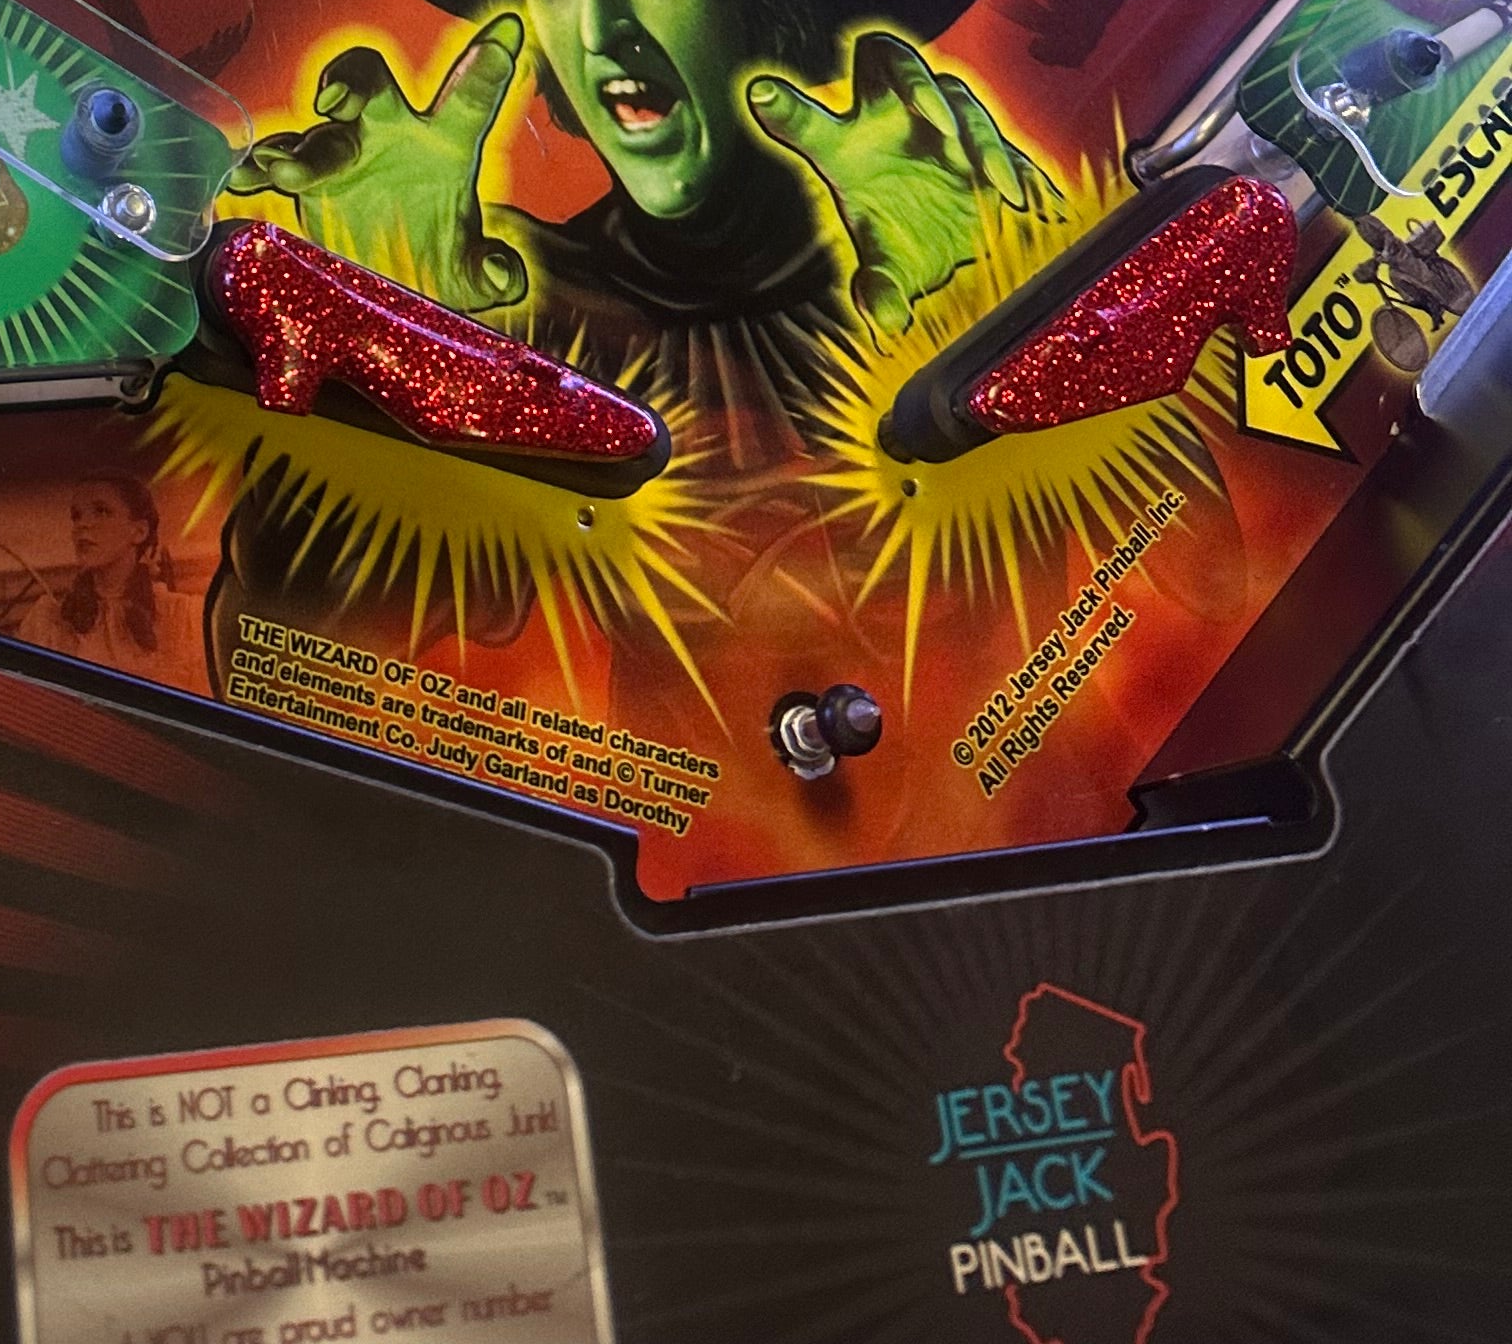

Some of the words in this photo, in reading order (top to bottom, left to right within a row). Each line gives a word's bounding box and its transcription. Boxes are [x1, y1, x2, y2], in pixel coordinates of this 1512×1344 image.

[1421, 77, 1512, 219] ESCA
[967, 691, 1015, 750] 2012
[1007, 630, 1068, 703] Jersey
[1059, 586, 1104, 638] Jack
[1092, 519, 1161, 593] Pinball,
[1147, 489, 1187, 526] Inc.
[233, 648, 275, 678] and
[276, 659, 377, 708] elements
[381, 694, 416, 720] are
[420, 703, 540, 757] trademarks
[545, 738, 572, 763] of
[572, 746, 613, 778] and
[640, 767, 711, 809] Turner
[239, 615, 286, 651] THE
[288, 630, 379, 677] WIZARD
[383, 661, 417, 688] OF
[419, 671, 453, 699] OZ
[457, 681, 497, 714] and
[501, 697, 527, 723] all
[531, 707, 605, 746] related
[608, 729, 720, 782] characters
[976, 756, 1009, 798] All
[999, 695, 1061, 766] Rights
[1050, 602, 1136, 703] Reserved.
[228, 675, 381, 742] Entertainment
[384, 723, 421, 754] Co.
[424, 734, 479, 772] Judy
[484, 752, 569, 796] Garland
[573, 782, 600, 806] as
[604, 789, 690, 836] Dorothy
[42, 1154, 168, 1191] Clattering
[181, 1133, 310, 1175] Collection
[323, 1122, 354, 1158] of
[364, 1115, 491, 1158] Caliginous
[93, 1098, 138, 1134] This
[148, 1097, 167, 1129] is
[178, 1085, 236, 1124] NOT
[251, 1091, 272, 1115] a
[928, 1068, 1116, 1165] JERSEY
[54, 1224, 109, 1261] This
[112, 1227, 134, 1255] is
[142, 1208, 228, 1255] THE
[237, 1187, 408, 1242] WIZARD
[417, 1179, 472, 1223] OF
[969, 1145, 1115, 1239] JACK
[202, 1250, 305, 1298] Pinball
[305, 1242, 428, 1285] Machine
[948, 1218, 1151, 1296] PINBALL
[278, 1302, 358, 1344] proud
[370, 1301, 449, 1336] owner
[460, 1283, 554, 1322] number
